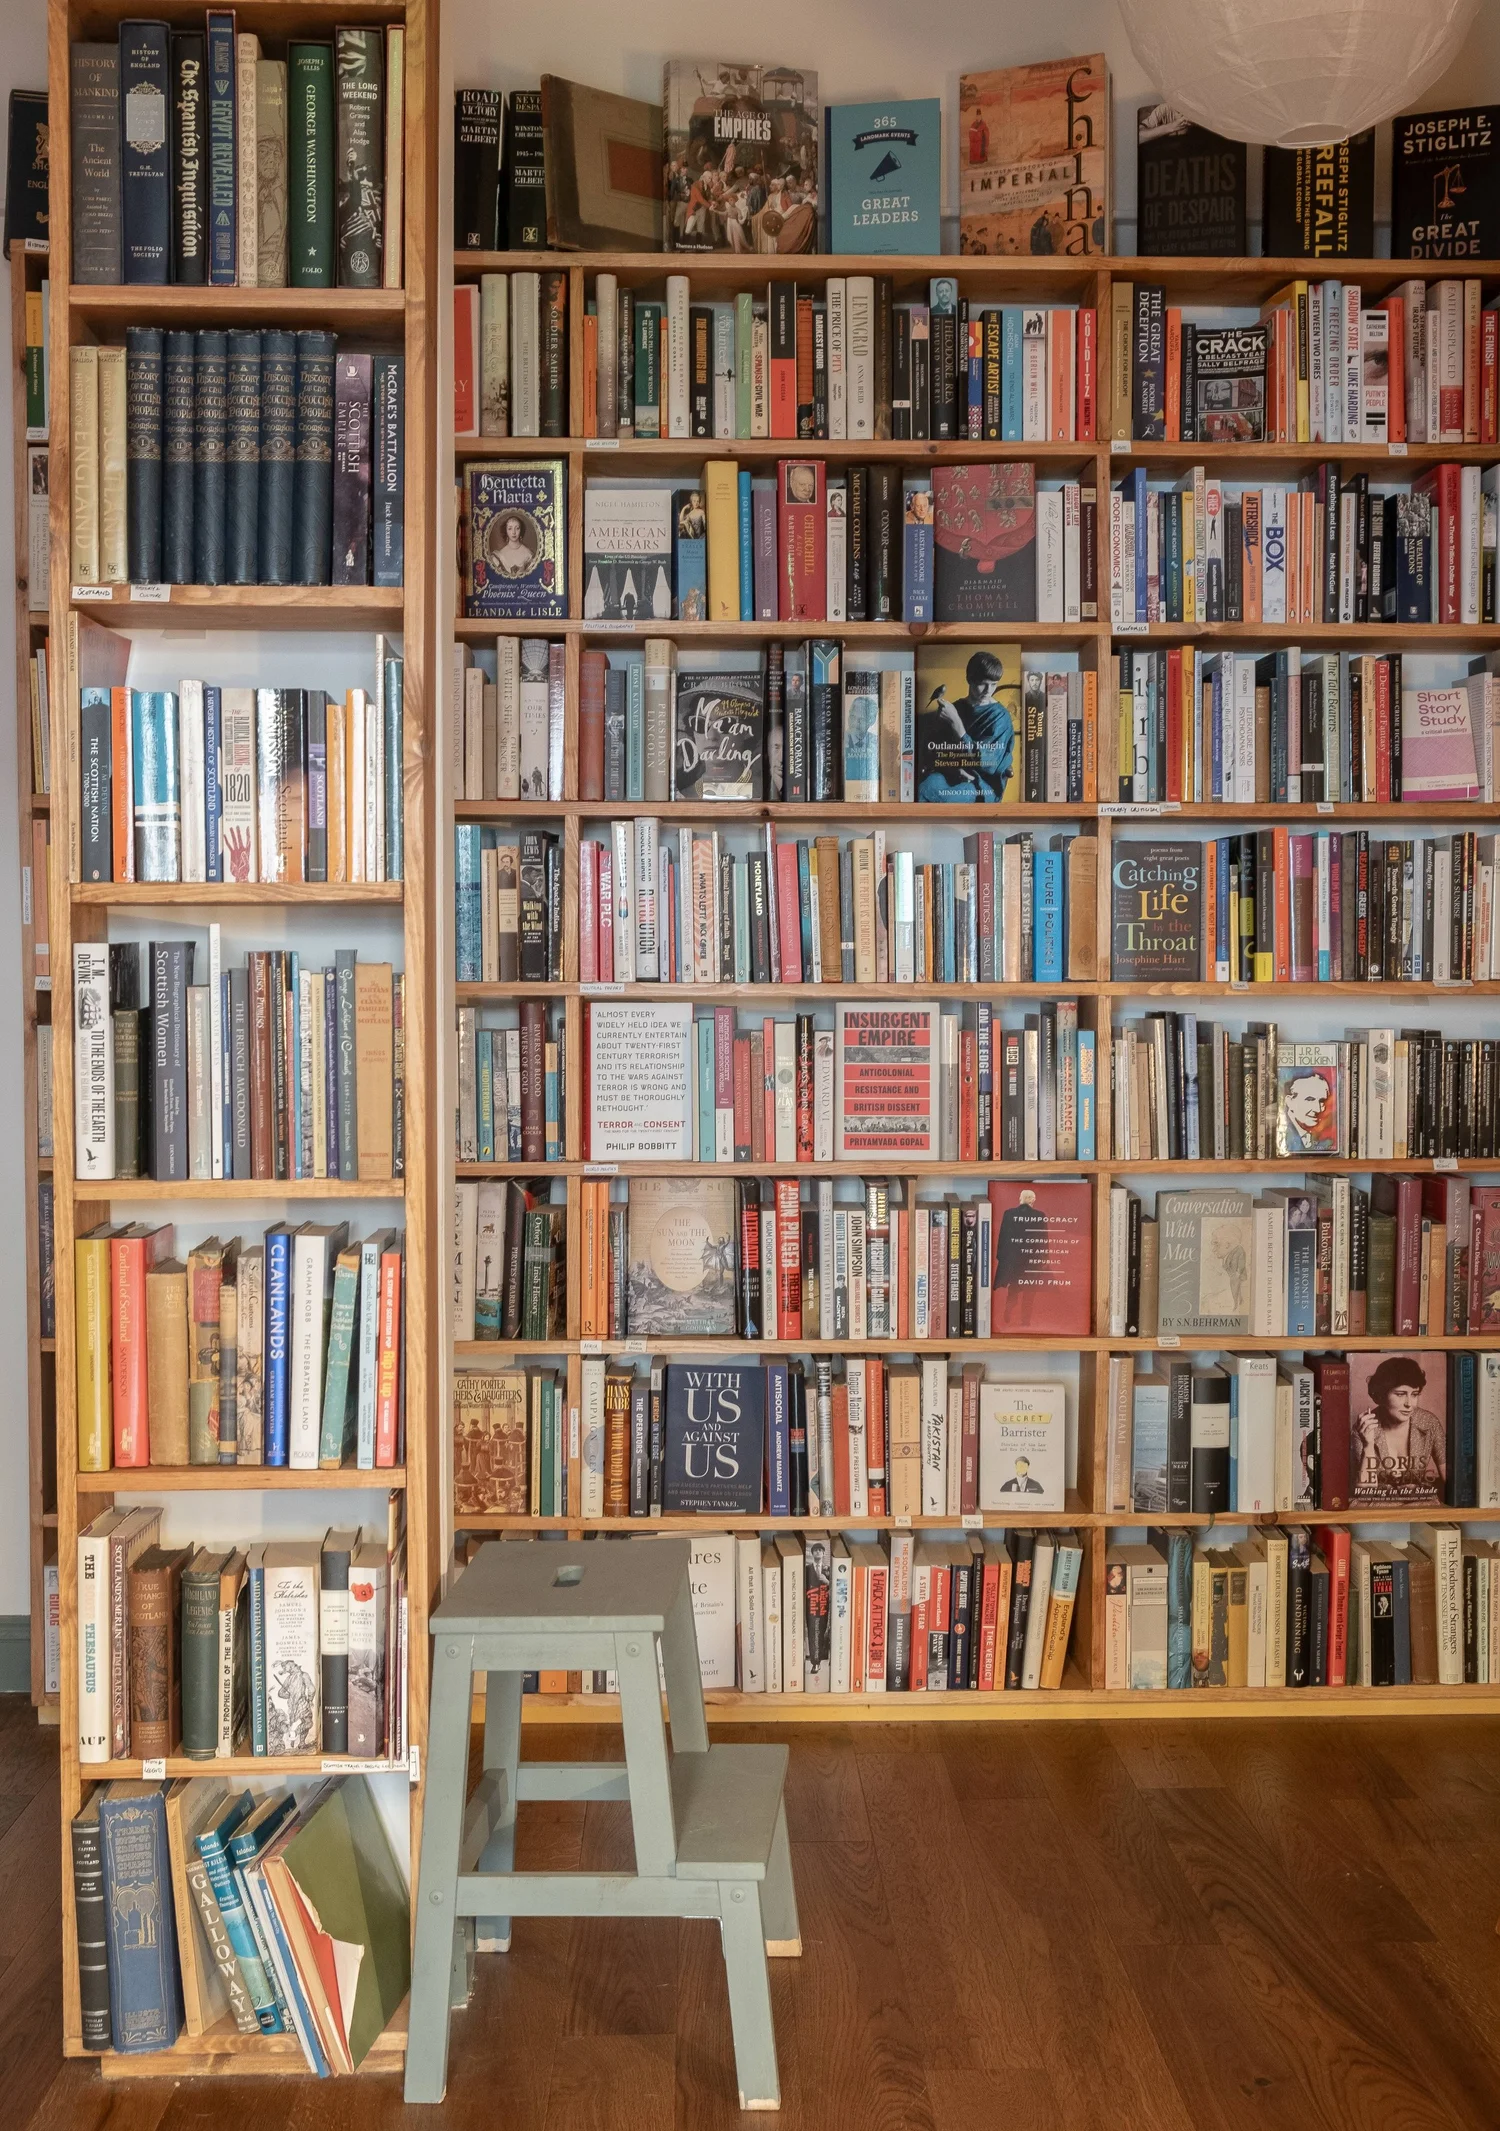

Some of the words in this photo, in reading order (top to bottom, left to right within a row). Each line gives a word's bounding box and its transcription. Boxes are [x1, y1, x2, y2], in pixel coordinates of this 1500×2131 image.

[74, 59, 116, 68] HISTORY
[89, 73, 102, 82] OF
[181, 60, 200, 86] The
[74, 88, 118, 98] MANKIND
[342, 83, 358, 91] THE
[360, 83, 377, 92] LONG
[342, 91, 377, 100] WEEKEND
[463, 92, 499, 103] ROAD
[306, 84, 316, 135] GEORGE
[462, 106, 497, 116] VICTORY
[714, 109, 734, 118] THE
[737, 110, 754, 119] AGE
[177, 90, 200, 159] Spanish
[461, 126, 497, 135] MARTIN
[714, 118, 771, 140] EMPIRES
[874, 117, 896, 129] 365
[1405, 121, 1469, 136] JOSEPH
[1477, 116, 1491, 129] E.
[461, 135, 497, 144] GILBERT
[1404, 131, 1491, 154] STIGLITZ
[306, 139, 316, 223] WASHINGTON
[971, 169, 1070, 193] IMPERIAL
[176, 162, 201, 258] Inquisition
[862, 197, 910, 210] GREAT
[853, 210, 918, 225] LEADERS
[1412, 221, 1480, 241] GREAT
[1411, 240, 1480, 259] DIVIDE
[1151, 291, 1161, 316] THE
[1139, 291, 1149, 363] DECEPTION
[1221, 331, 1242, 339] THE
[1150, 323, 1160, 363] GREAT
[1196, 337, 1265, 354] CRACK
[388, 365, 396, 412] McCRAE'S
[388, 422, 396, 492] BATTALION
[480, 474, 545, 491] Henrietta
[493, 488, 533, 504] Maria
[588, 527, 666, 538] AMERICAN
[596, 539, 659, 550] CAESARS
[1265, 526, 1284, 573] BOX
[469, 608, 513, 617] LEANDA
[516, 608, 526, 616] de
[530, 607, 561, 616] LISLE
[1417, 692, 1461, 702] Short
[690, 697, 754, 738] Ma'am
[1418, 704, 1461, 716] Story
[1419, 714, 1466, 727] Study
[928, 741, 971, 750] Outlandish
[972, 741, 1005, 750] Knight
[677, 738, 761, 772] Darling
[225, 775, 250, 801] 1820
[1045, 859, 1053, 905] FUTURE
[1113, 860, 1199, 890] Catching
[1138, 884, 1188, 920] Life
[1152, 924, 1164, 932] by
[1168, 920, 1191, 932] the
[1044, 912, 1053, 965] POLITICS
[1117, 923, 1196, 951] Throat
[1116, 955, 1160, 965] Josephine
[1163, 955, 1185, 963] Hart
[157, 951, 168, 1010] Scottish
[844, 1012, 930, 1028] INSURGENT
[157, 1014, 166, 1068] Women
[858, 1030, 915, 1045] EMPIRE
[1299, 1057, 1334, 1065] TOLKIEN
[860, 1069, 914, 1077] ANTICOLONIAL
[855, 1086, 902, 1094] RESISTANCE
[904, 1086, 919, 1094] AND
[854, 1103, 885, 1112] BRITISH
[888, 1103, 920, 1112] DISSENT
[639, 1142, 676, 1150] BOBBITT
[850, 1138, 898, 1146] PRIYAMVADA
[901, 1138, 924, 1146] GOPAL
[1165, 1197, 1244, 1215] Conversation
[673, 1219, 691, 1227] THE
[1164, 1220, 1196, 1238] With
[657, 1228, 674, 1237] SUN
[689, 1228, 706, 1237] THE
[668, 1238, 695, 1247] MOON
[1321, 1222, 1330, 1271] Bukowski
[1164, 1244, 1197, 1260] Max
[270, 1245, 284, 1360] CLANLANDS
[1162, 1318, 1174, 1326] BY
[1250, 1362, 1269, 1371] Keats
[685, 1372, 740, 1388] WITH
[684, 1388, 740, 1423] US
[1014, 1400, 1032, 1411] The
[1003, 1414, 1043, 1422] SECRET
[702, 1423, 721, 1431] AND
[1001, 1427, 1046, 1438] Barrister
[682, 1432, 739, 1442] AGAINST
[682, 1443, 739, 1478] US
[1366, 1457, 1426, 1471] DORIS
[1357, 1469, 1436, 1485] LESSING
[1449, 1538, 1458, 1550] The
[1450, 1551, 1458, 1593] Kindness
[1450, 1597, 1457, 1606] of
[85, 1624, 95, 1693] THESAURUS
